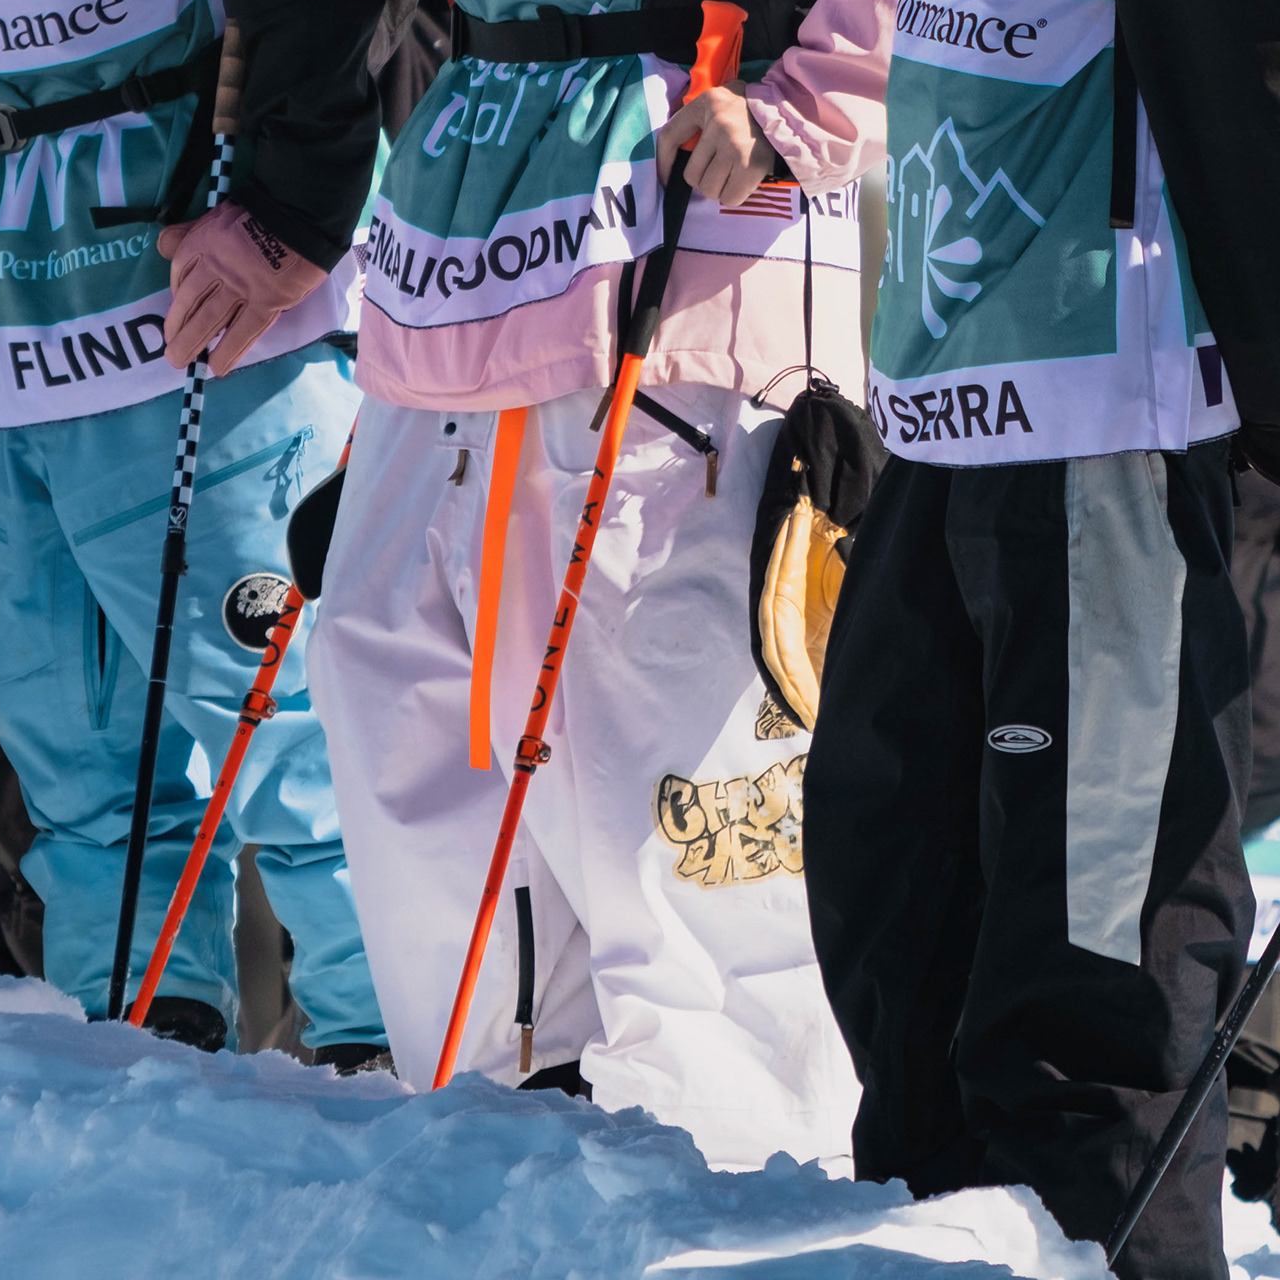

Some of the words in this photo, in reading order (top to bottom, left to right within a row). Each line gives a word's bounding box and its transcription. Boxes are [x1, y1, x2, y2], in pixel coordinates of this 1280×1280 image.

[15, 311, 167, 391] FLIND
[887, 380, 1035, 445] SERRA
[530, 606, 570, 713] ONE
[569, 465, 606, 565] WAY
